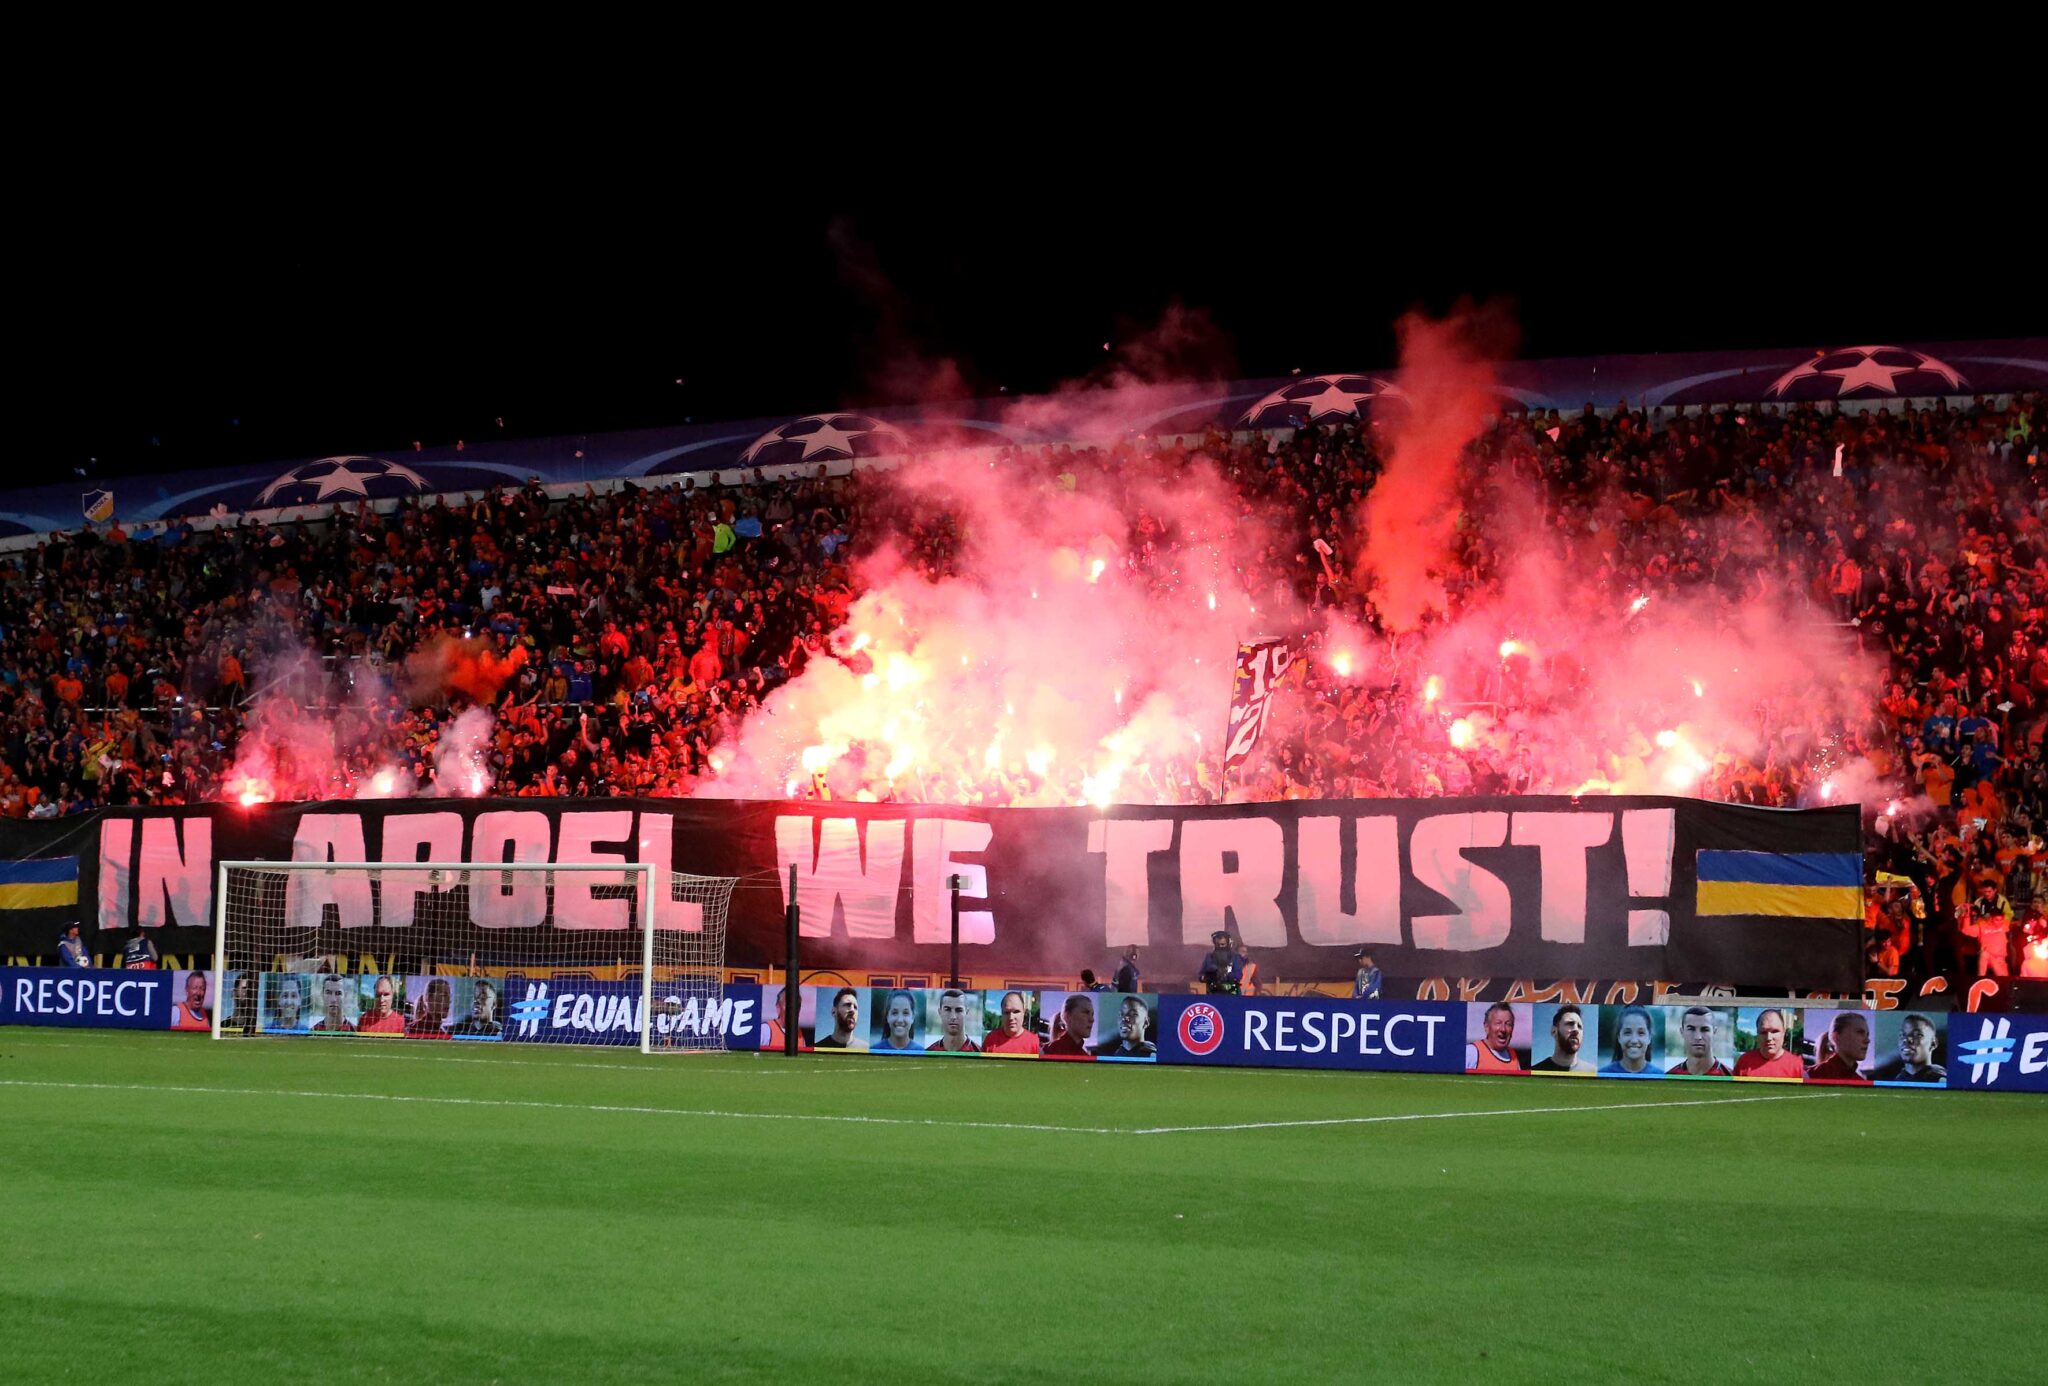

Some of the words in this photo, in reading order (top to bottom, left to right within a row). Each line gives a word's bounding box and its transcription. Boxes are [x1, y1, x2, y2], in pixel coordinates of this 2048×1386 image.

[98, 816, 213, 930] IN
[285, 811, 704, 932] APOEL
[774, 815, 996, 945] WE
[1087, 807, 1676, 952] TRUST!
[15, 978, 159, 1017] RESPECT
[1187, 1006, 1215, 1019] UEFA
[1244, 1010, 1446, 1057] RESPECT
[1957, 1017, 2048, 1085] #E
